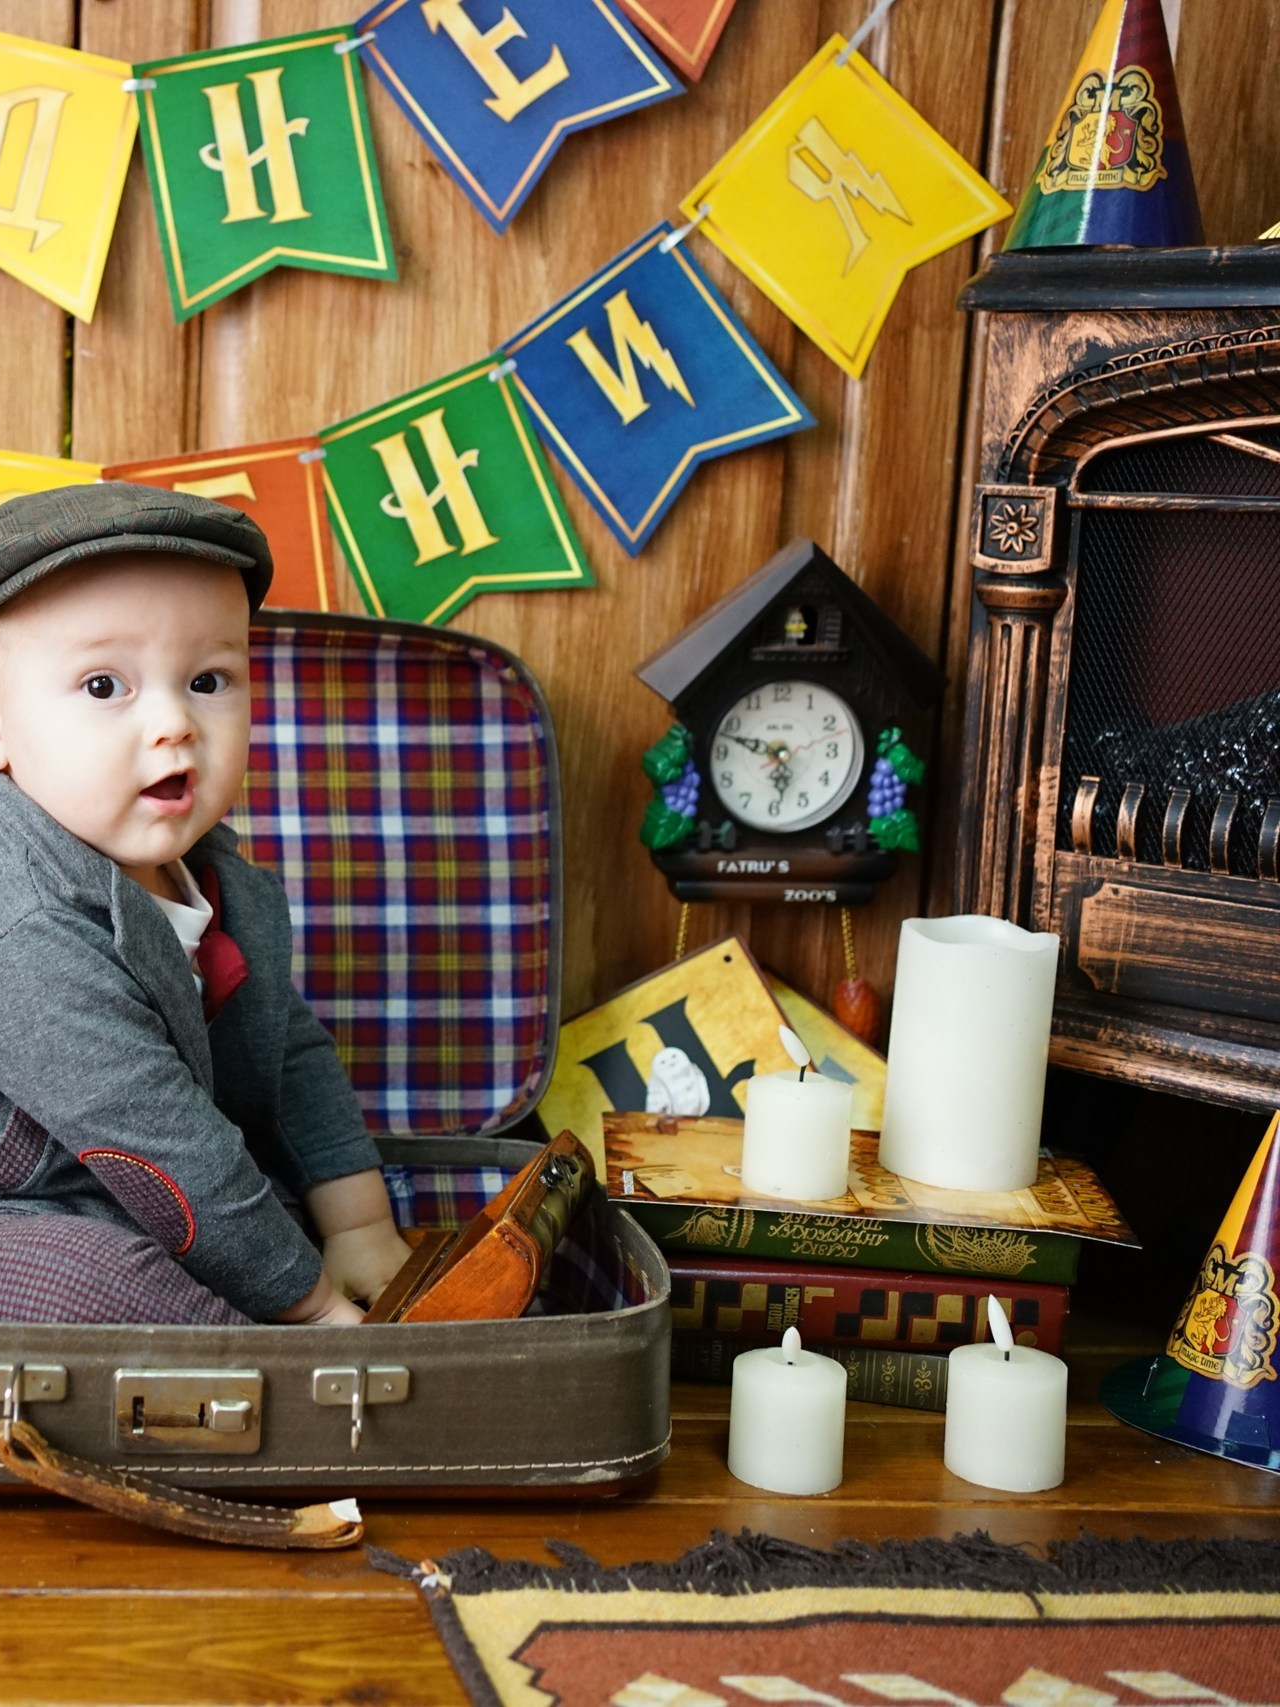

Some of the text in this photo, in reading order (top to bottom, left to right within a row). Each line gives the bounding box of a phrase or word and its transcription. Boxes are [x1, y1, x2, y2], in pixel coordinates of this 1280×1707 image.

[1098, 172, 1118, 182] time
[746, 693, 761, 711] 11
[773, 684, 792, 703] 12
[806, 693, 814, 710] 1
[724, 715, 741, 732] 10
[823, 715, 837, 731] 2
[716, 745, 729, 761] 9
[826, 742, 838, 759] 3
[721, 772, 734, 789] 8
[819, 770, 830, 787] 4
[739, 792, 752, 809] 7
[797, 791, 810, 808] 5
[768, 800, 780, 817] 6
[784, 889, 837, 902] ZOO'S
[768, 1222, 889, 1246] АНГЛИЙСКИХ
[791, 1241, 859, 1258] СКАЗКИ
[1211, 1267, 1239, 1297] M
[767, 1303, 783, 1332] ДЖОН
[783, 1287, 800, 1333] ТЕЙНБЕК
[1181, 1347, 1220, 1371] magic time
